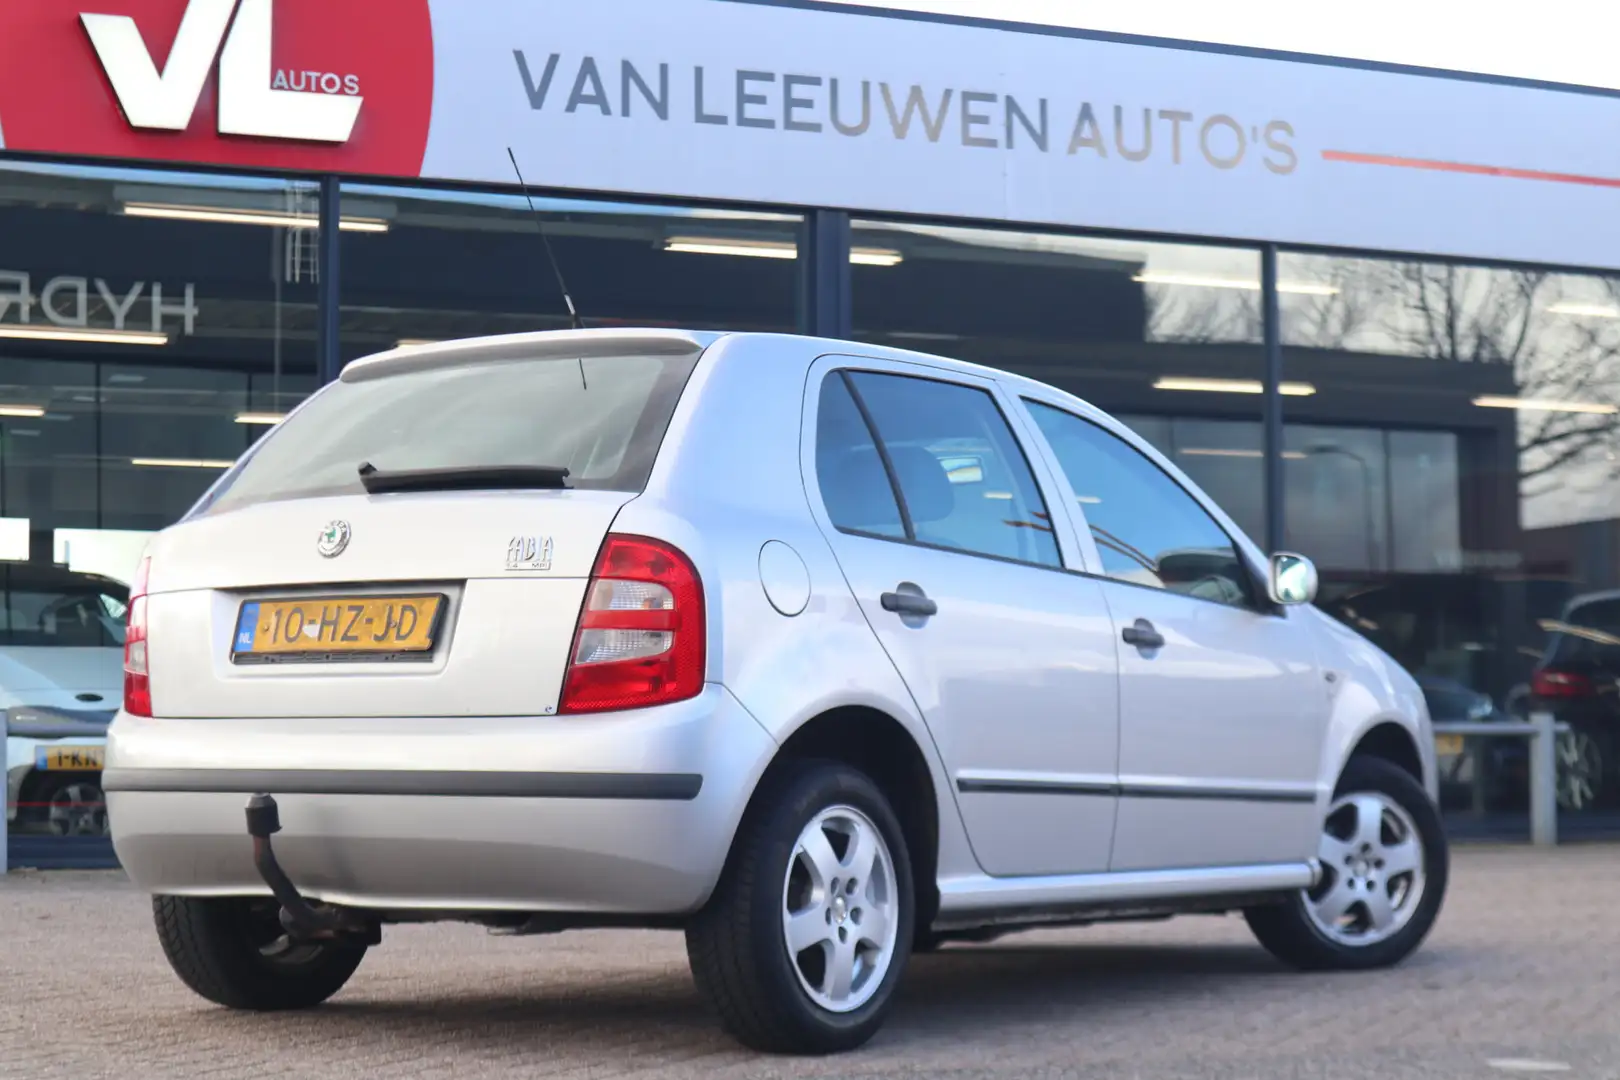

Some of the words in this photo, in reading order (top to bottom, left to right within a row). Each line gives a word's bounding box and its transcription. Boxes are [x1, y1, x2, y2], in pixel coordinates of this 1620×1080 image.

[272, 68, 360, 95] AUTOS
[512, 49, 669, 121] VAN
[694, 65, 1048, 153] LEEUWEN
[1067, 102, 1298, 175] AUTO'S
[271, 604, 418, 645] 10-HZ-JD
